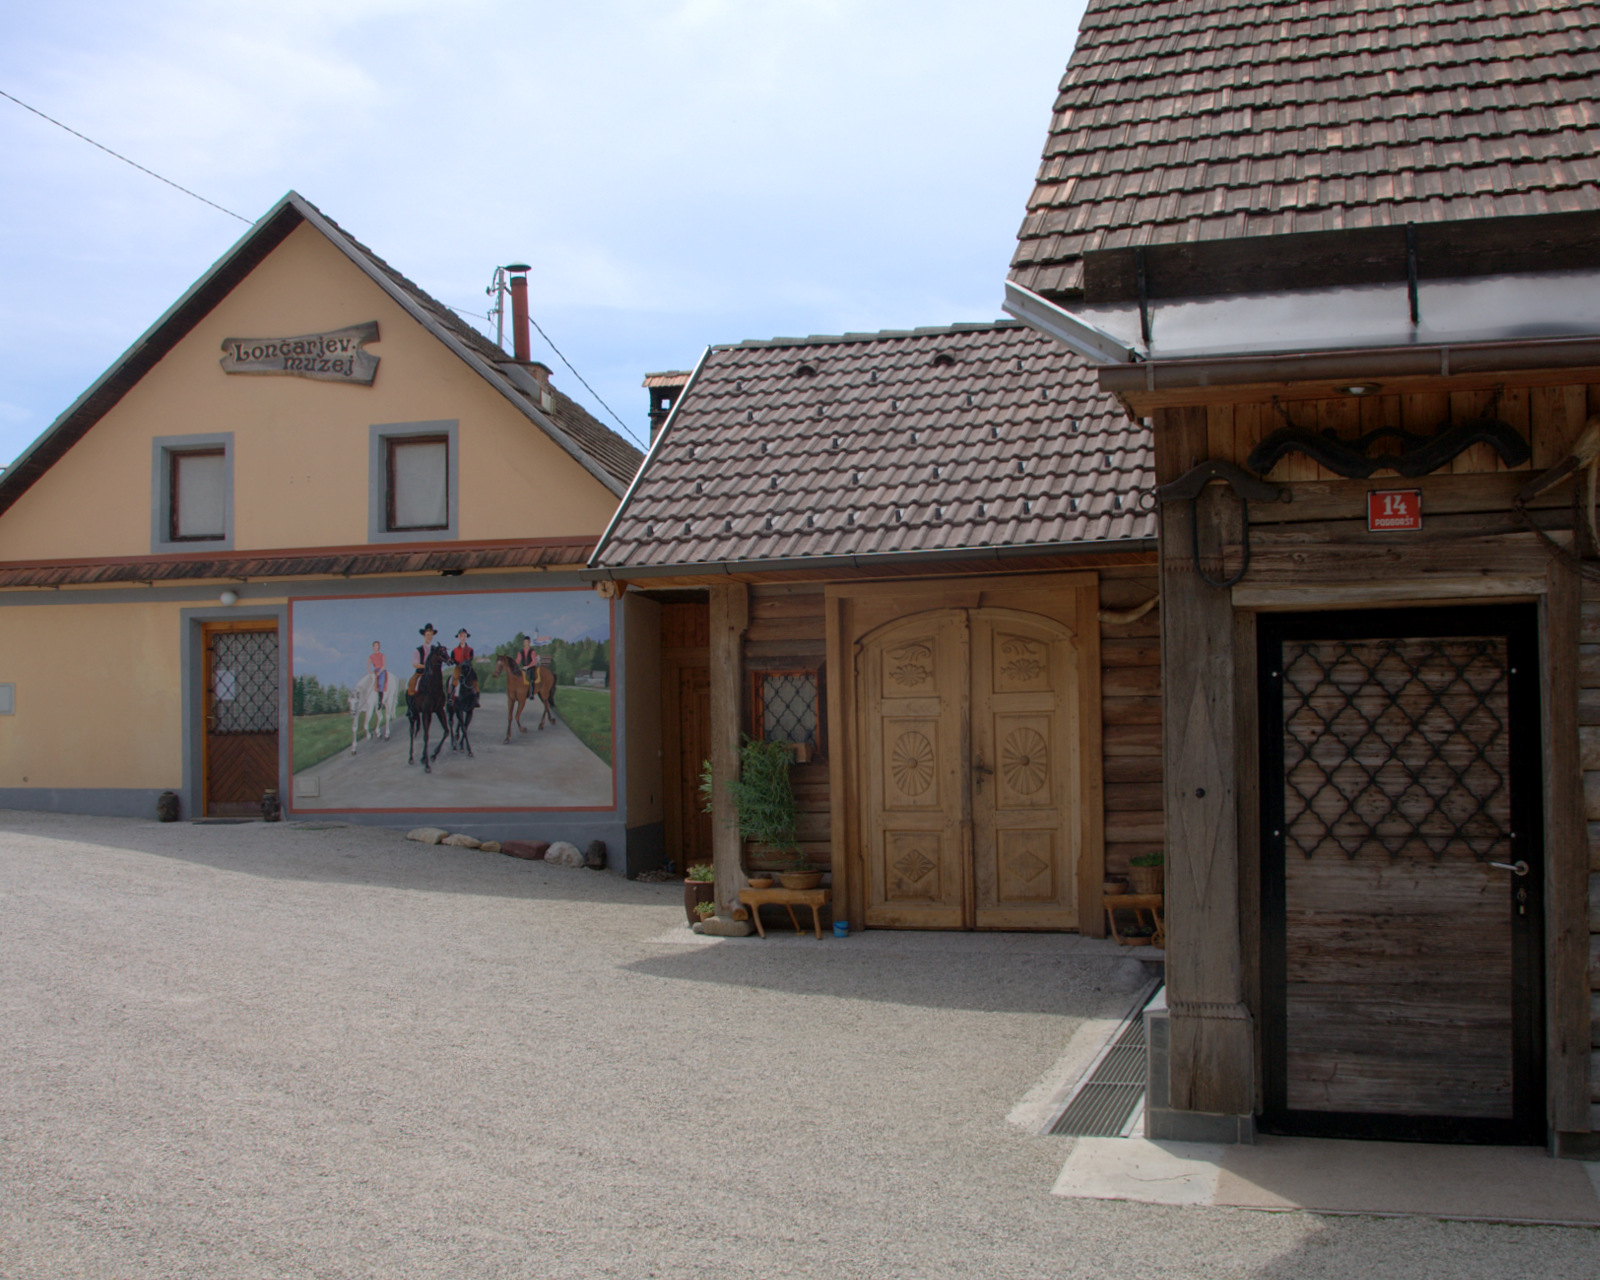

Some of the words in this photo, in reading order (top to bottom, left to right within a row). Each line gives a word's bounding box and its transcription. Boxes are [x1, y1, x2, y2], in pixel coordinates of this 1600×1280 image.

[233, 337, 351, 362] Lončarjev
[283, 355, 354, 376] muzej
[1383, 495, 1407, 515] 14
